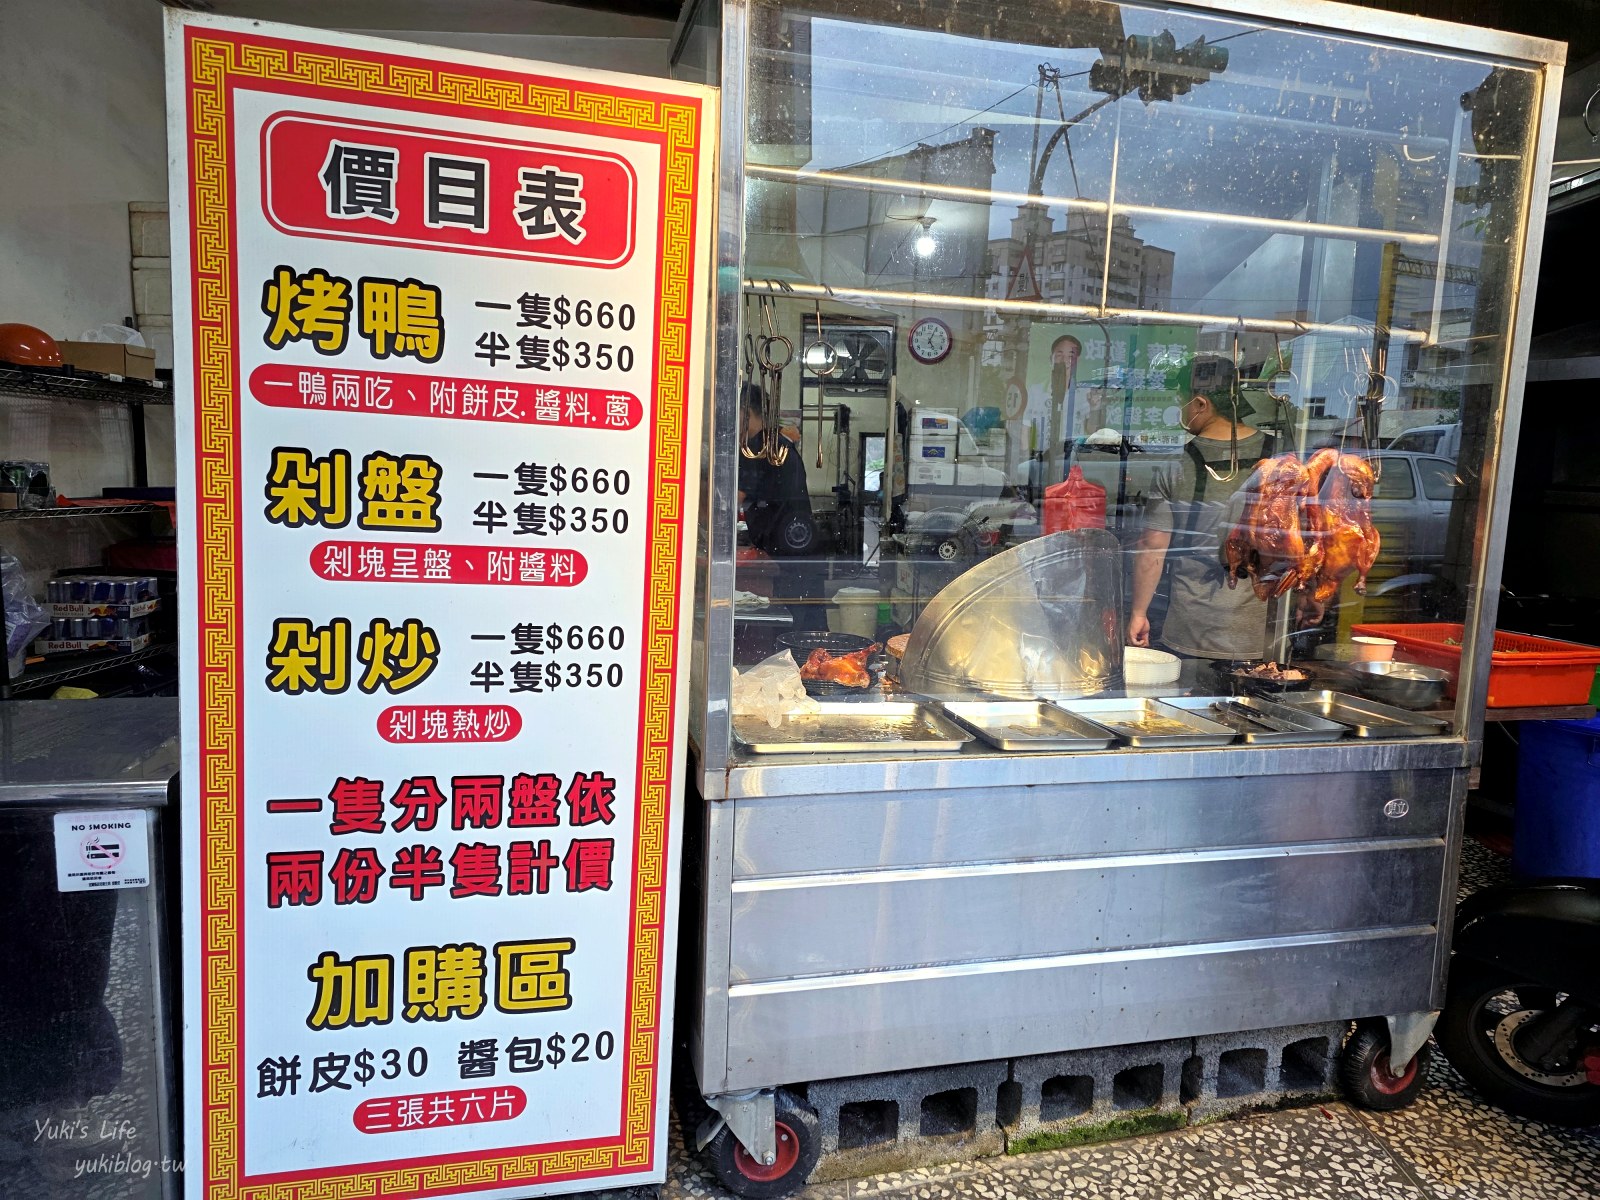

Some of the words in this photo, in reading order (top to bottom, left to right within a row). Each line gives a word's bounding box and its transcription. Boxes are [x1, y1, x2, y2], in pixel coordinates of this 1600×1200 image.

[319, 139, 586, 245] 價目表
[262, 265, 445, 363] 烤鴨
[474, 291, 636, 333] 一隻$660
[474, 331, 635, 374] 半隻$350
[265, 447, 443, 534] 剁盤
[473, 462, 632, 499] 一隻$660
[473, 499, 630, 537] 半隻$350
[323, 547, 577, 585] 剁塊呈盤、附醬料
[53, 604, 69, 612] Red
[69, 604, 84, 612] Bull
[48, 641, 64, 649] Red
[64, 641, 82, 649] Bull
[265, 618, 442, 696] 剁炒
[470, 622, 625, 657] 一隻$660
[470, 659, 624, 694] 半隻$350
[388, 709, 512, 742] 剁塊熱炒
[266, 772, 617, 837] 一隻分兩盤依
[88, 822, 132, 831] SMOKING
[266, 839, 616, 909] 兩份半隻計價
[306, 938, 577, 1031] 加購區
[255, 1047, 429, 1098] 餅皮$30
[457, 1031, 615, 1080] 醬包$20
[364, 1091, 517, 1131] 三張共六片
